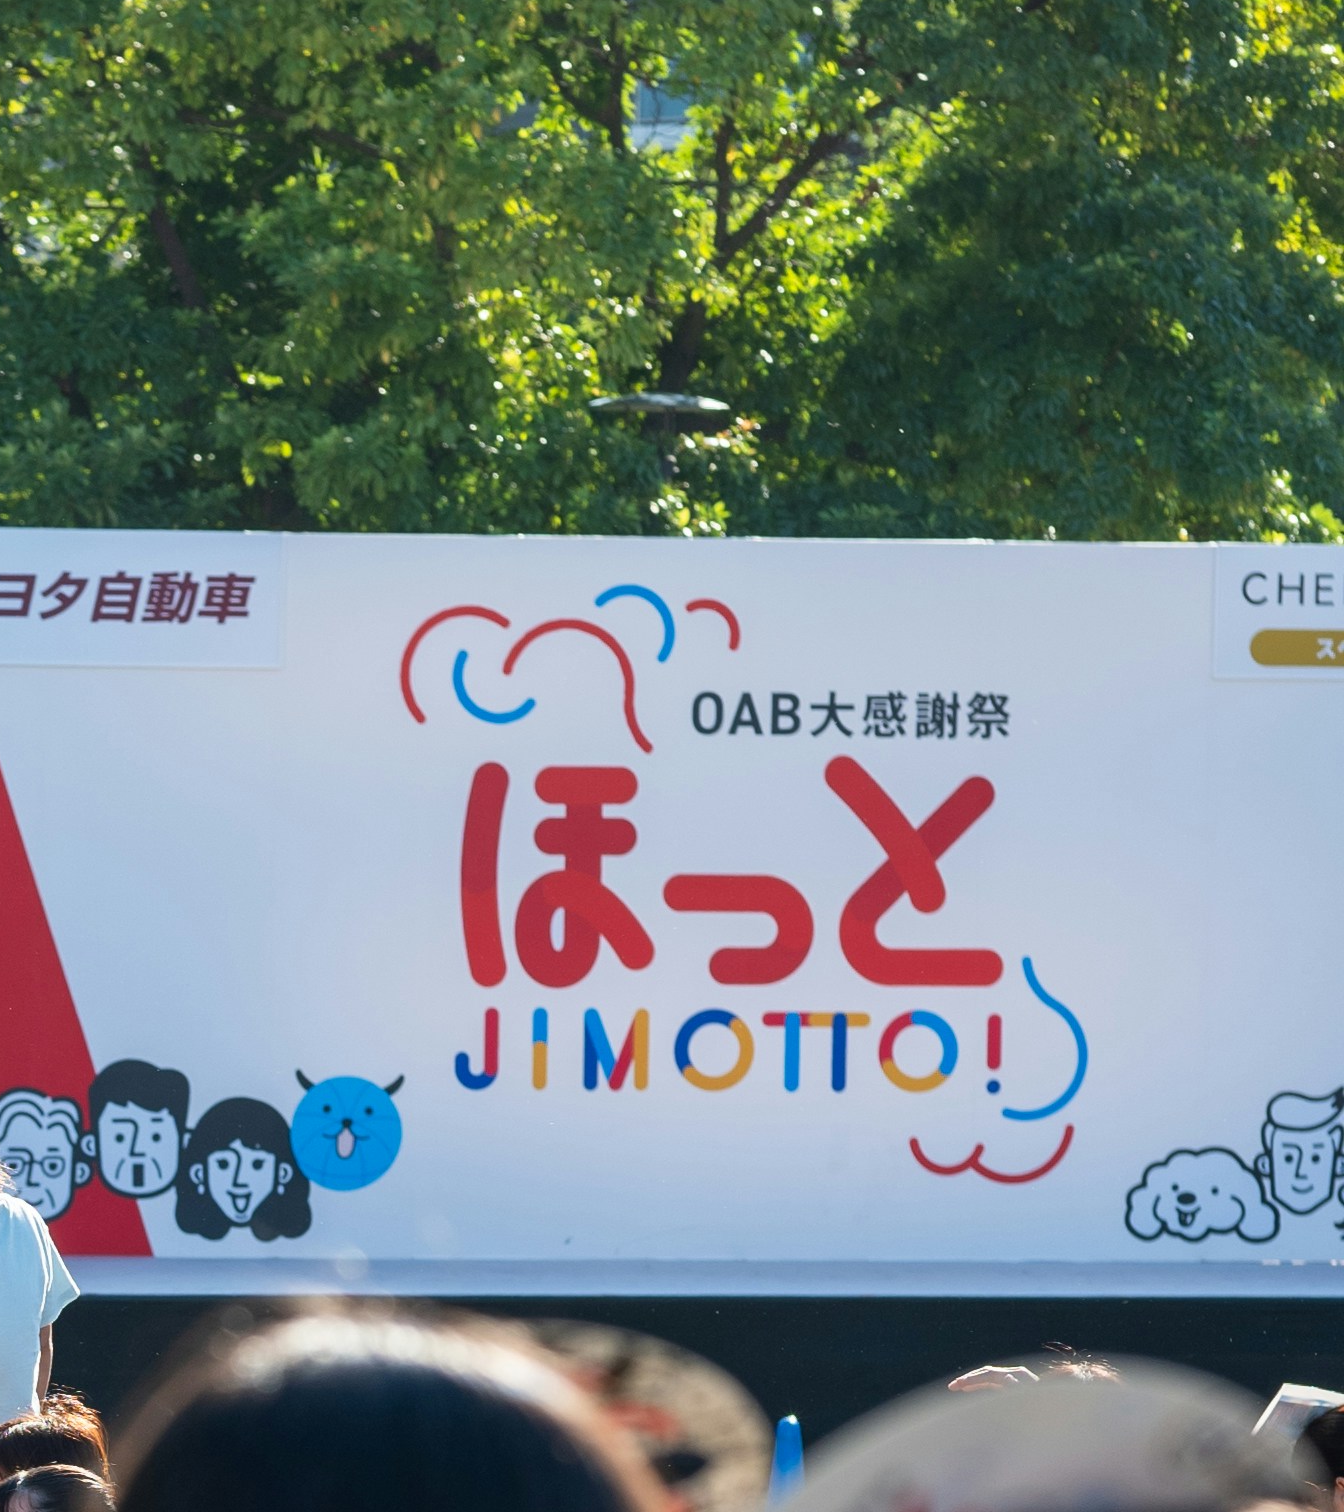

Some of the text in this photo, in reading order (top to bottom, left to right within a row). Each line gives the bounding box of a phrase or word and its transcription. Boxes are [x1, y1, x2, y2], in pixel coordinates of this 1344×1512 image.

[1242, 571, 1344, 606] CHE
[692, 690, 1012, 739] OAB大感謝祭
[459, 753, 1004, 988] ほっと
[454, 1007, 1002, 1094] JIMOTTO!
